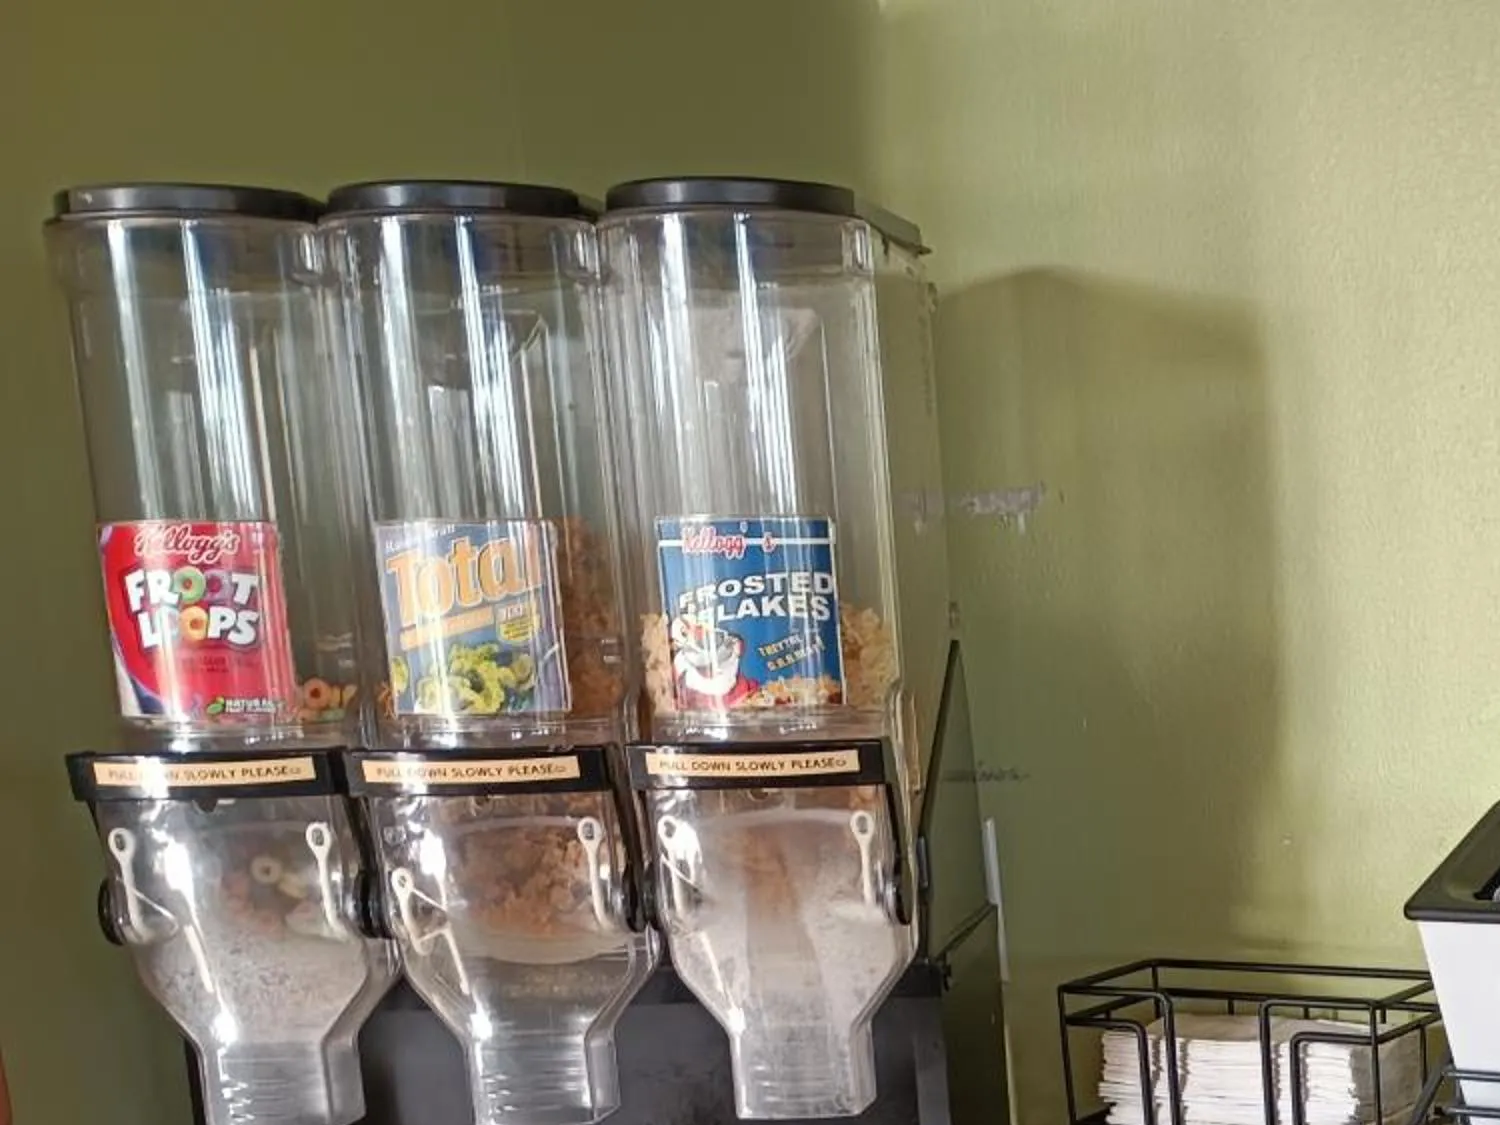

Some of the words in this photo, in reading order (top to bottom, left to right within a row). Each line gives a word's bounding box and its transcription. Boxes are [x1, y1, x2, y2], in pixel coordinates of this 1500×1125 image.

[134, 524, 240, 564] Kellogg's
[125, 566, 260, 612] FROOT
[680, 571, 834, 610] FROSTED
[138, 605, 259, 649] LOOPS
[184, 768, 236, 781] SLOWLY
[241, 765, 290, 778] PLEASE
[451, 766, 503, 778] SLOWLY
[507, 763, 553, 776] PLEASE
[659, 760, 688, 772] PULL
[691, 760, 731, 771] DOWN
[735, 760, 785, 772] SLOWLY
[791, 757, 835, 769] PLEASE
